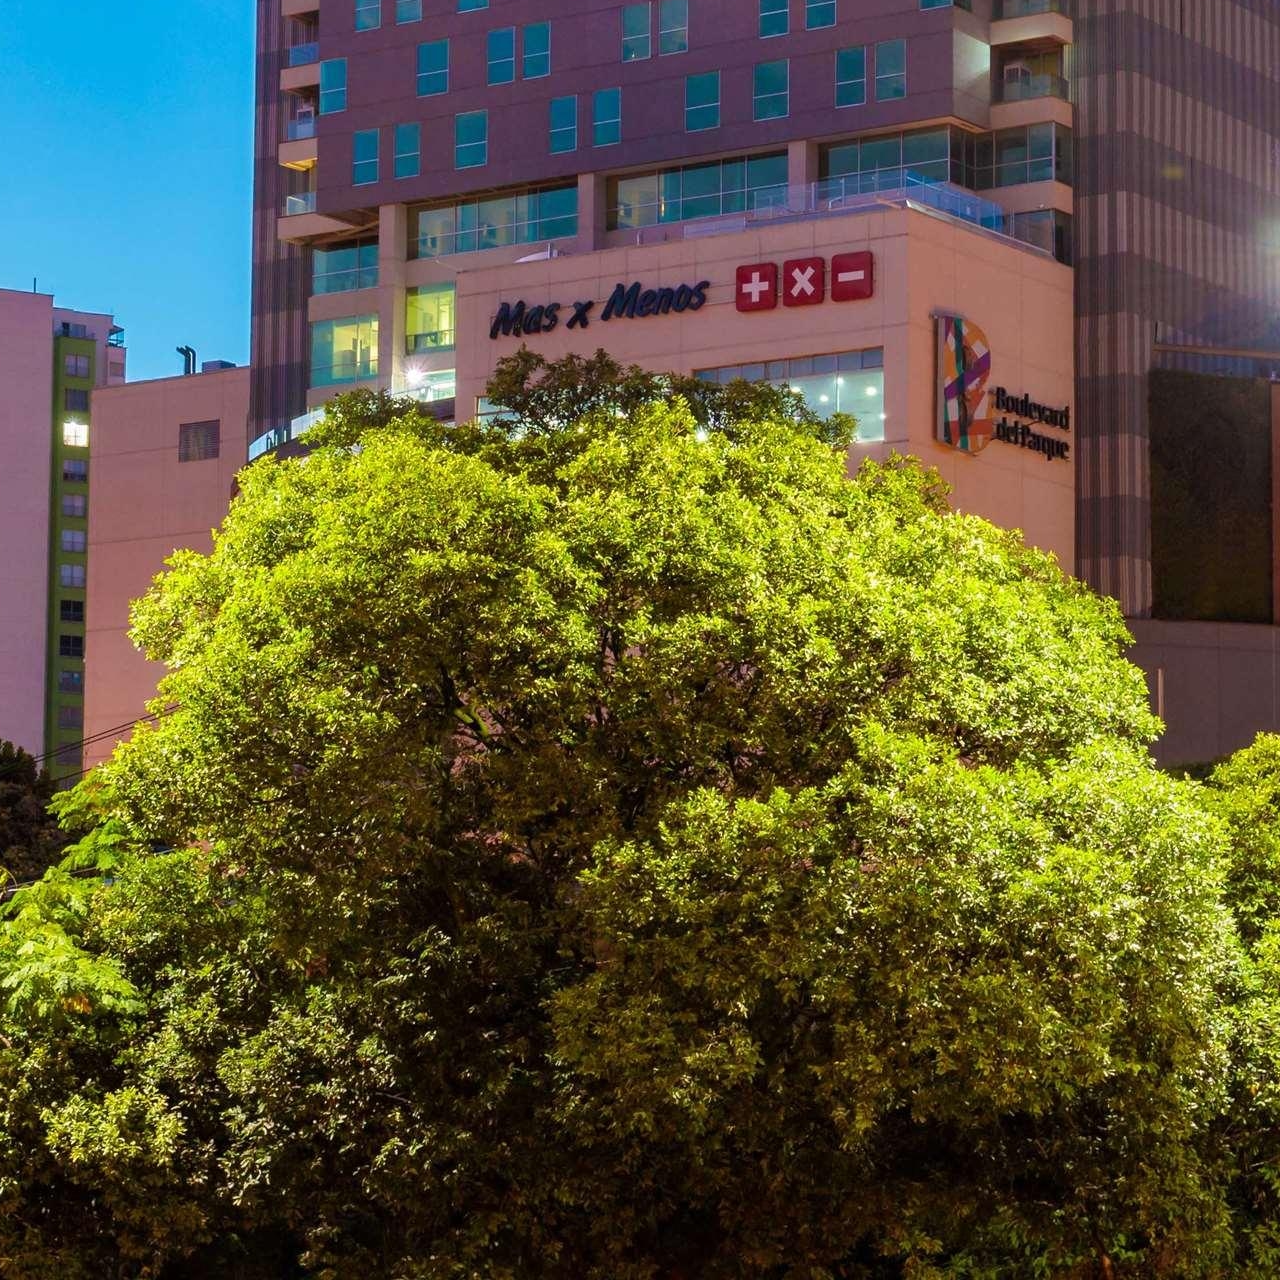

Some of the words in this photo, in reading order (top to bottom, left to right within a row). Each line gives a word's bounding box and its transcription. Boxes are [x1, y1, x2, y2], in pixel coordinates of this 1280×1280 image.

[489, 300, 560, 339] Mas
[600, 280, 710, 320] Menos
[996, 387, 1070, 429] Boulevard
